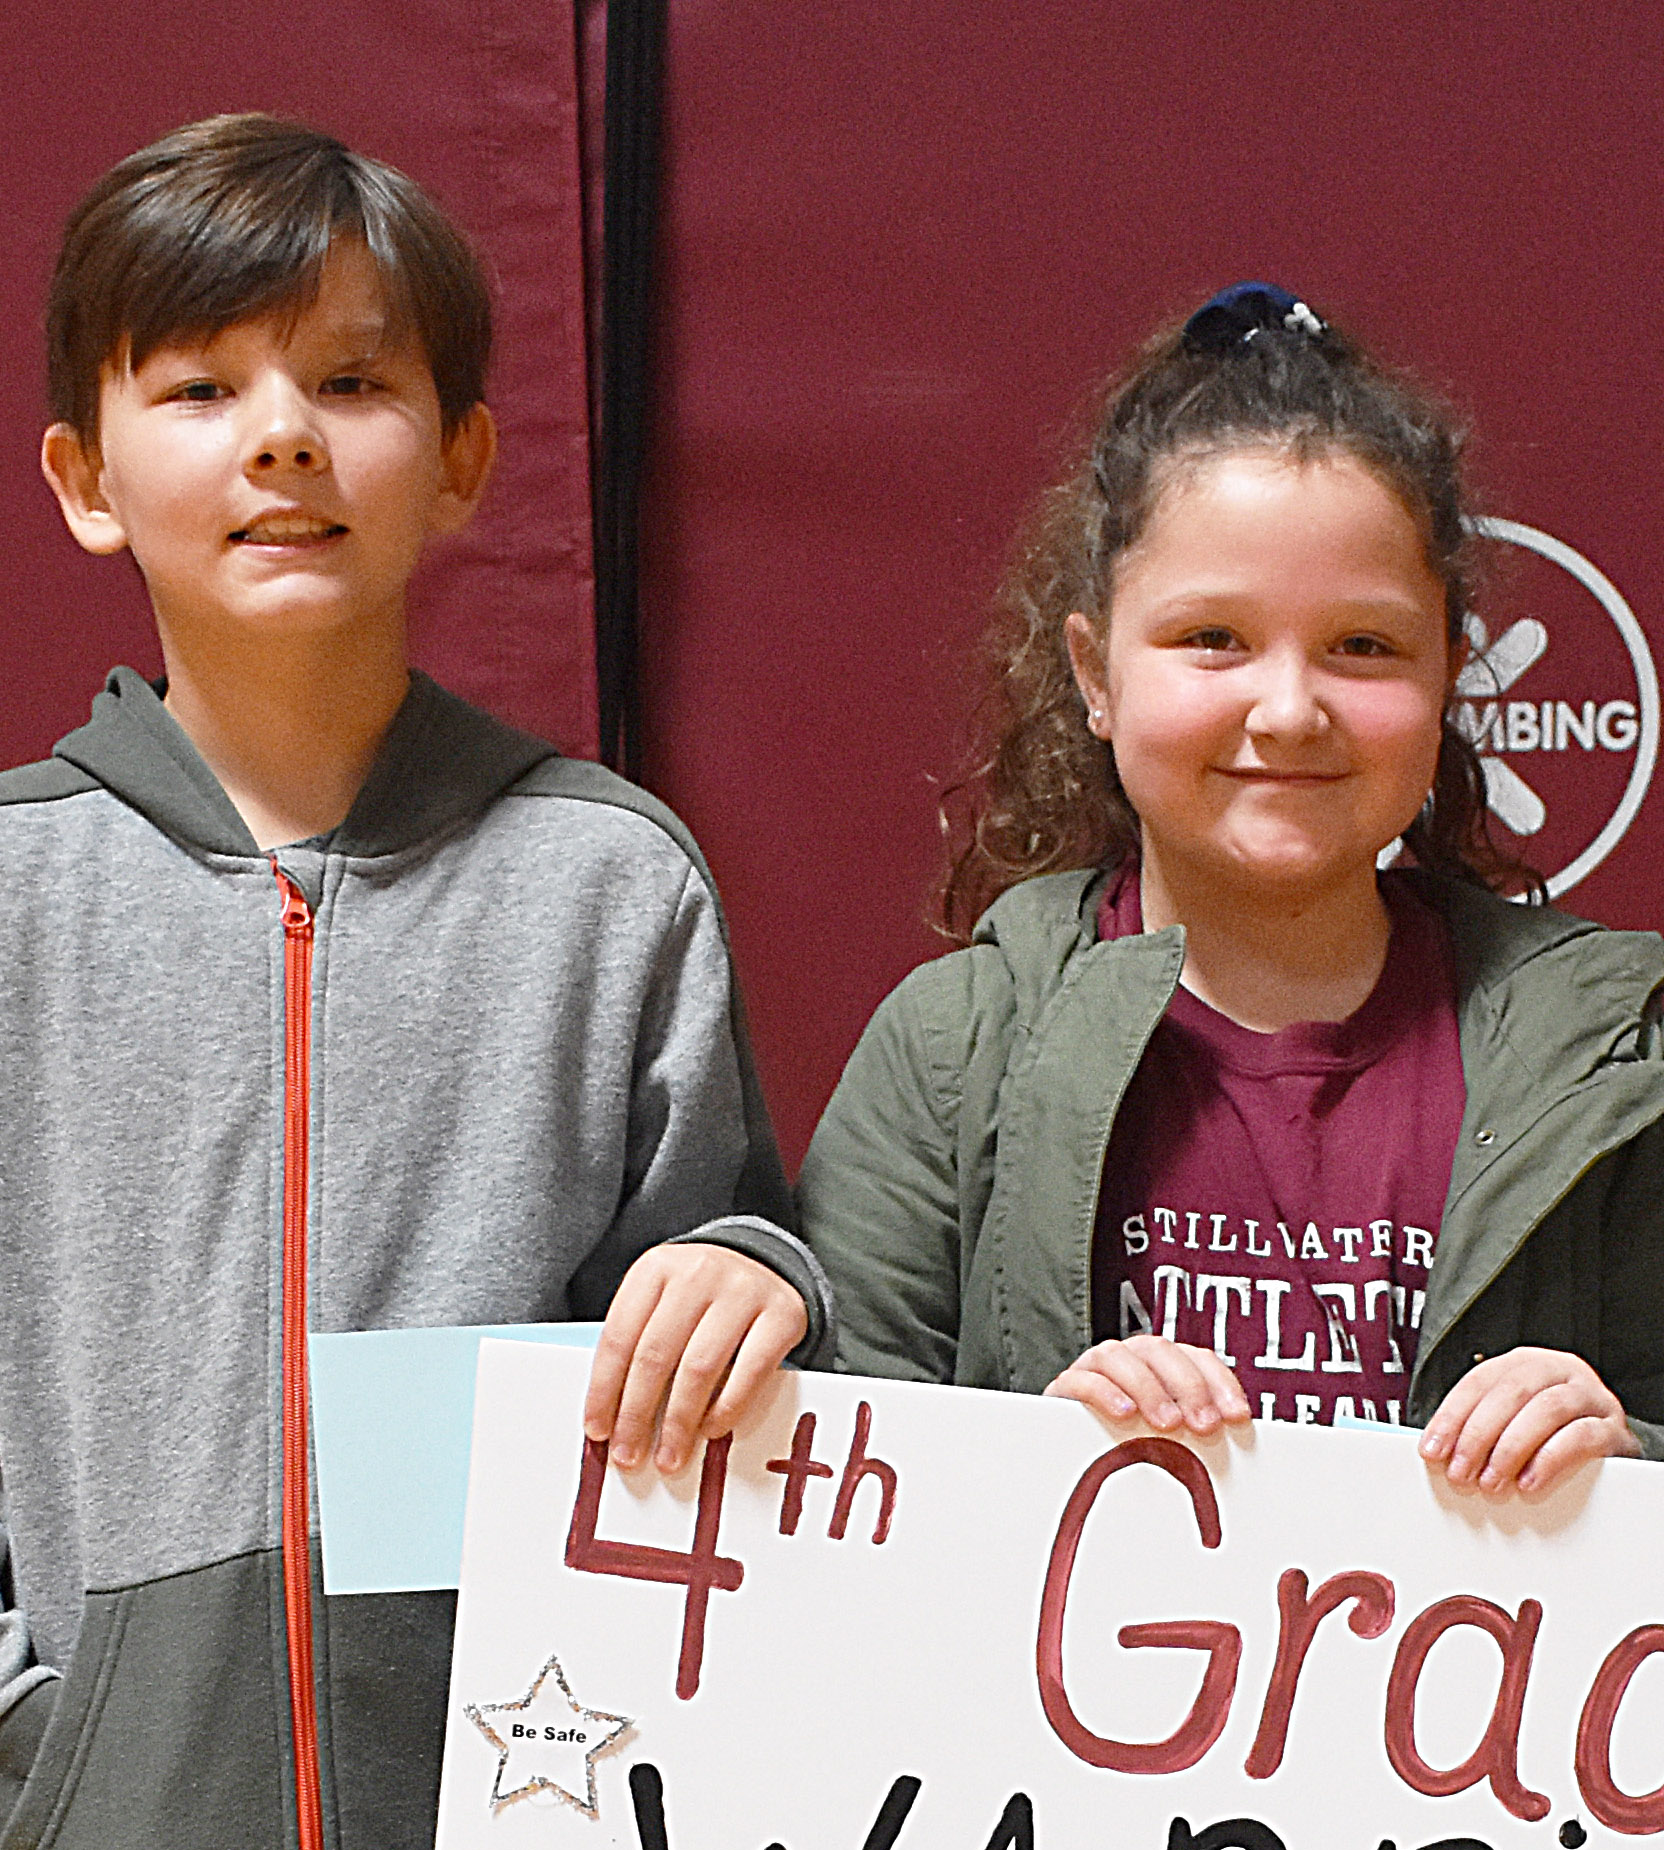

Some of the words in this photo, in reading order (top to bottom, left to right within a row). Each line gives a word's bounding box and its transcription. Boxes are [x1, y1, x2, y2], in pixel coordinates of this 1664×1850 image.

[1122, 1207, 1435, 1270] STILLATER
[563, 1400, 898, 1701] 4th
[511, 1723, 537, 1739] Be
[543, 1726, 587, 1743] Safe
